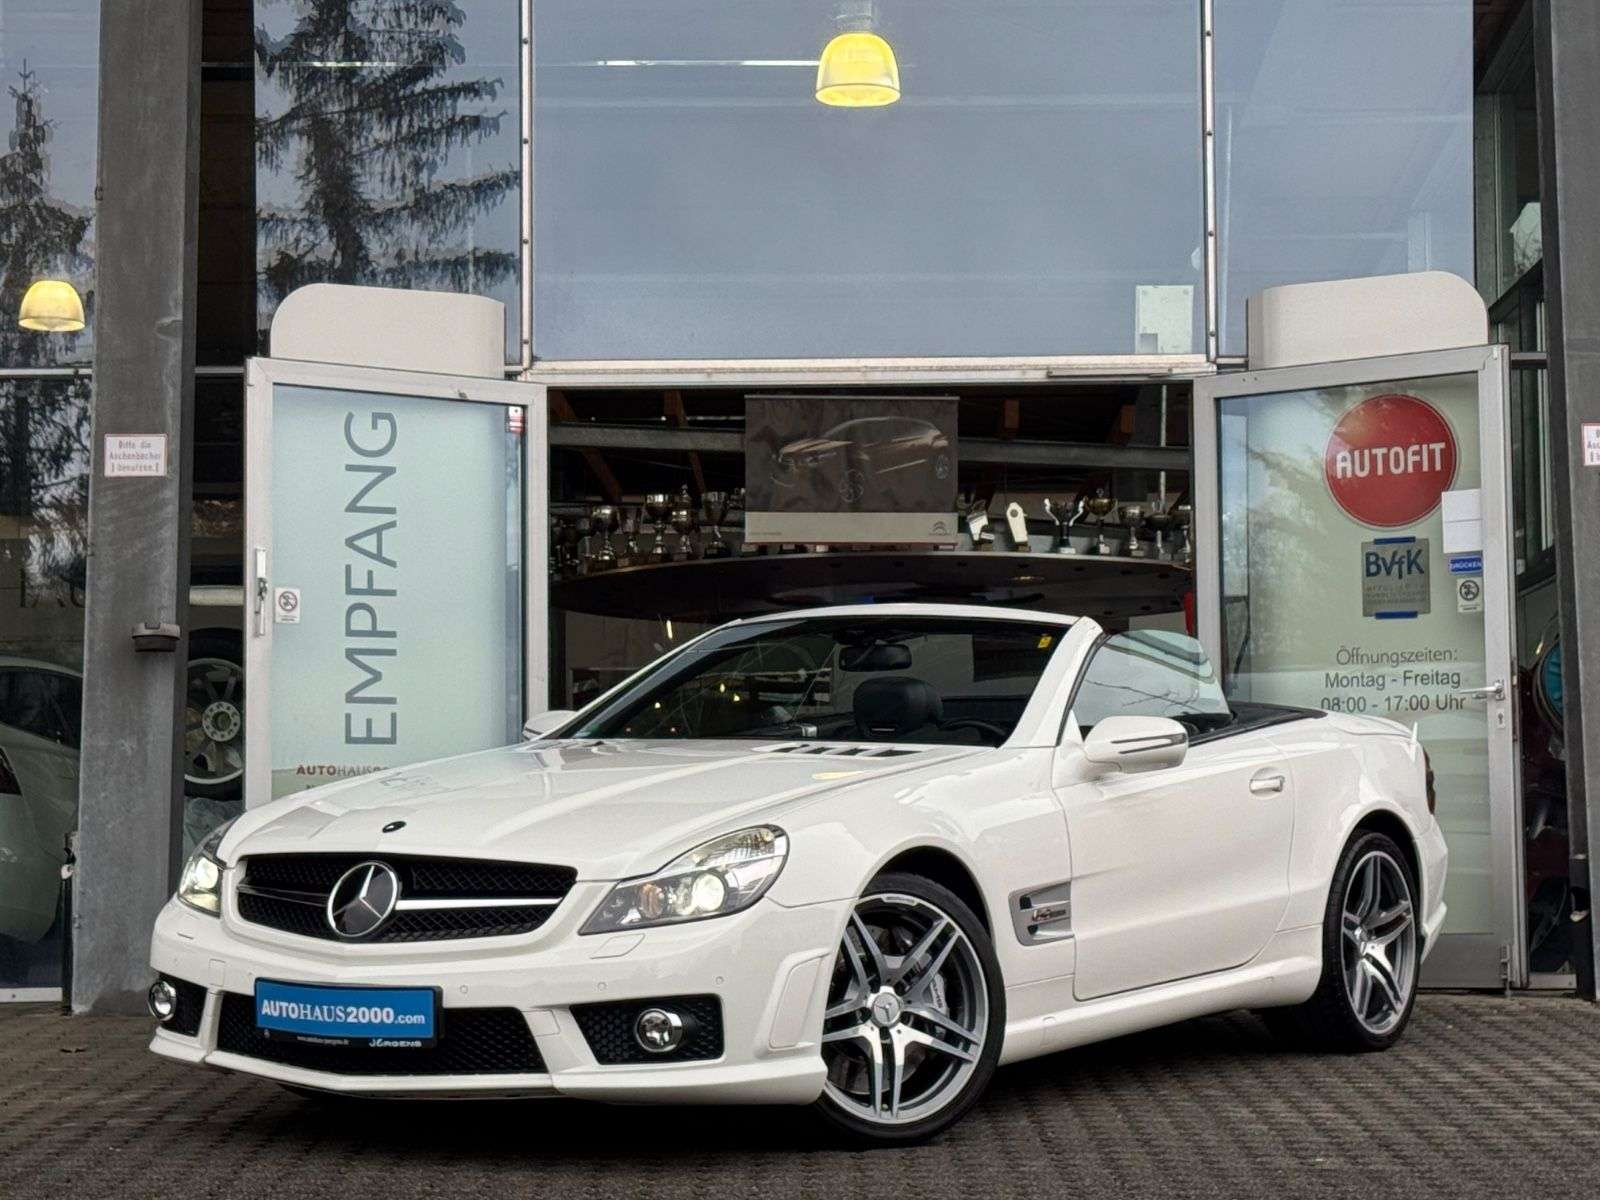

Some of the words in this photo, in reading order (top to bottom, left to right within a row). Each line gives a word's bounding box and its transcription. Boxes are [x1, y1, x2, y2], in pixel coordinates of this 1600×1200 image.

[1336, 442, 1446, 479] AUTOFIT
[344, 411, 397, 745] EMPFANG
[1336, 645, 1458, 668] Öffnungszeiten:
[1325, 672, 1386, 691] Montag
[1403, 669, 1461, 689] Freitag
[1320, 696, 1367, 713] 08:00
[1385, 695, 1430, 712] 17:00
[1436, 694, 1466, 711] Uhr
[262, 999, 426, 1025] AUTOHAUS2000.com
